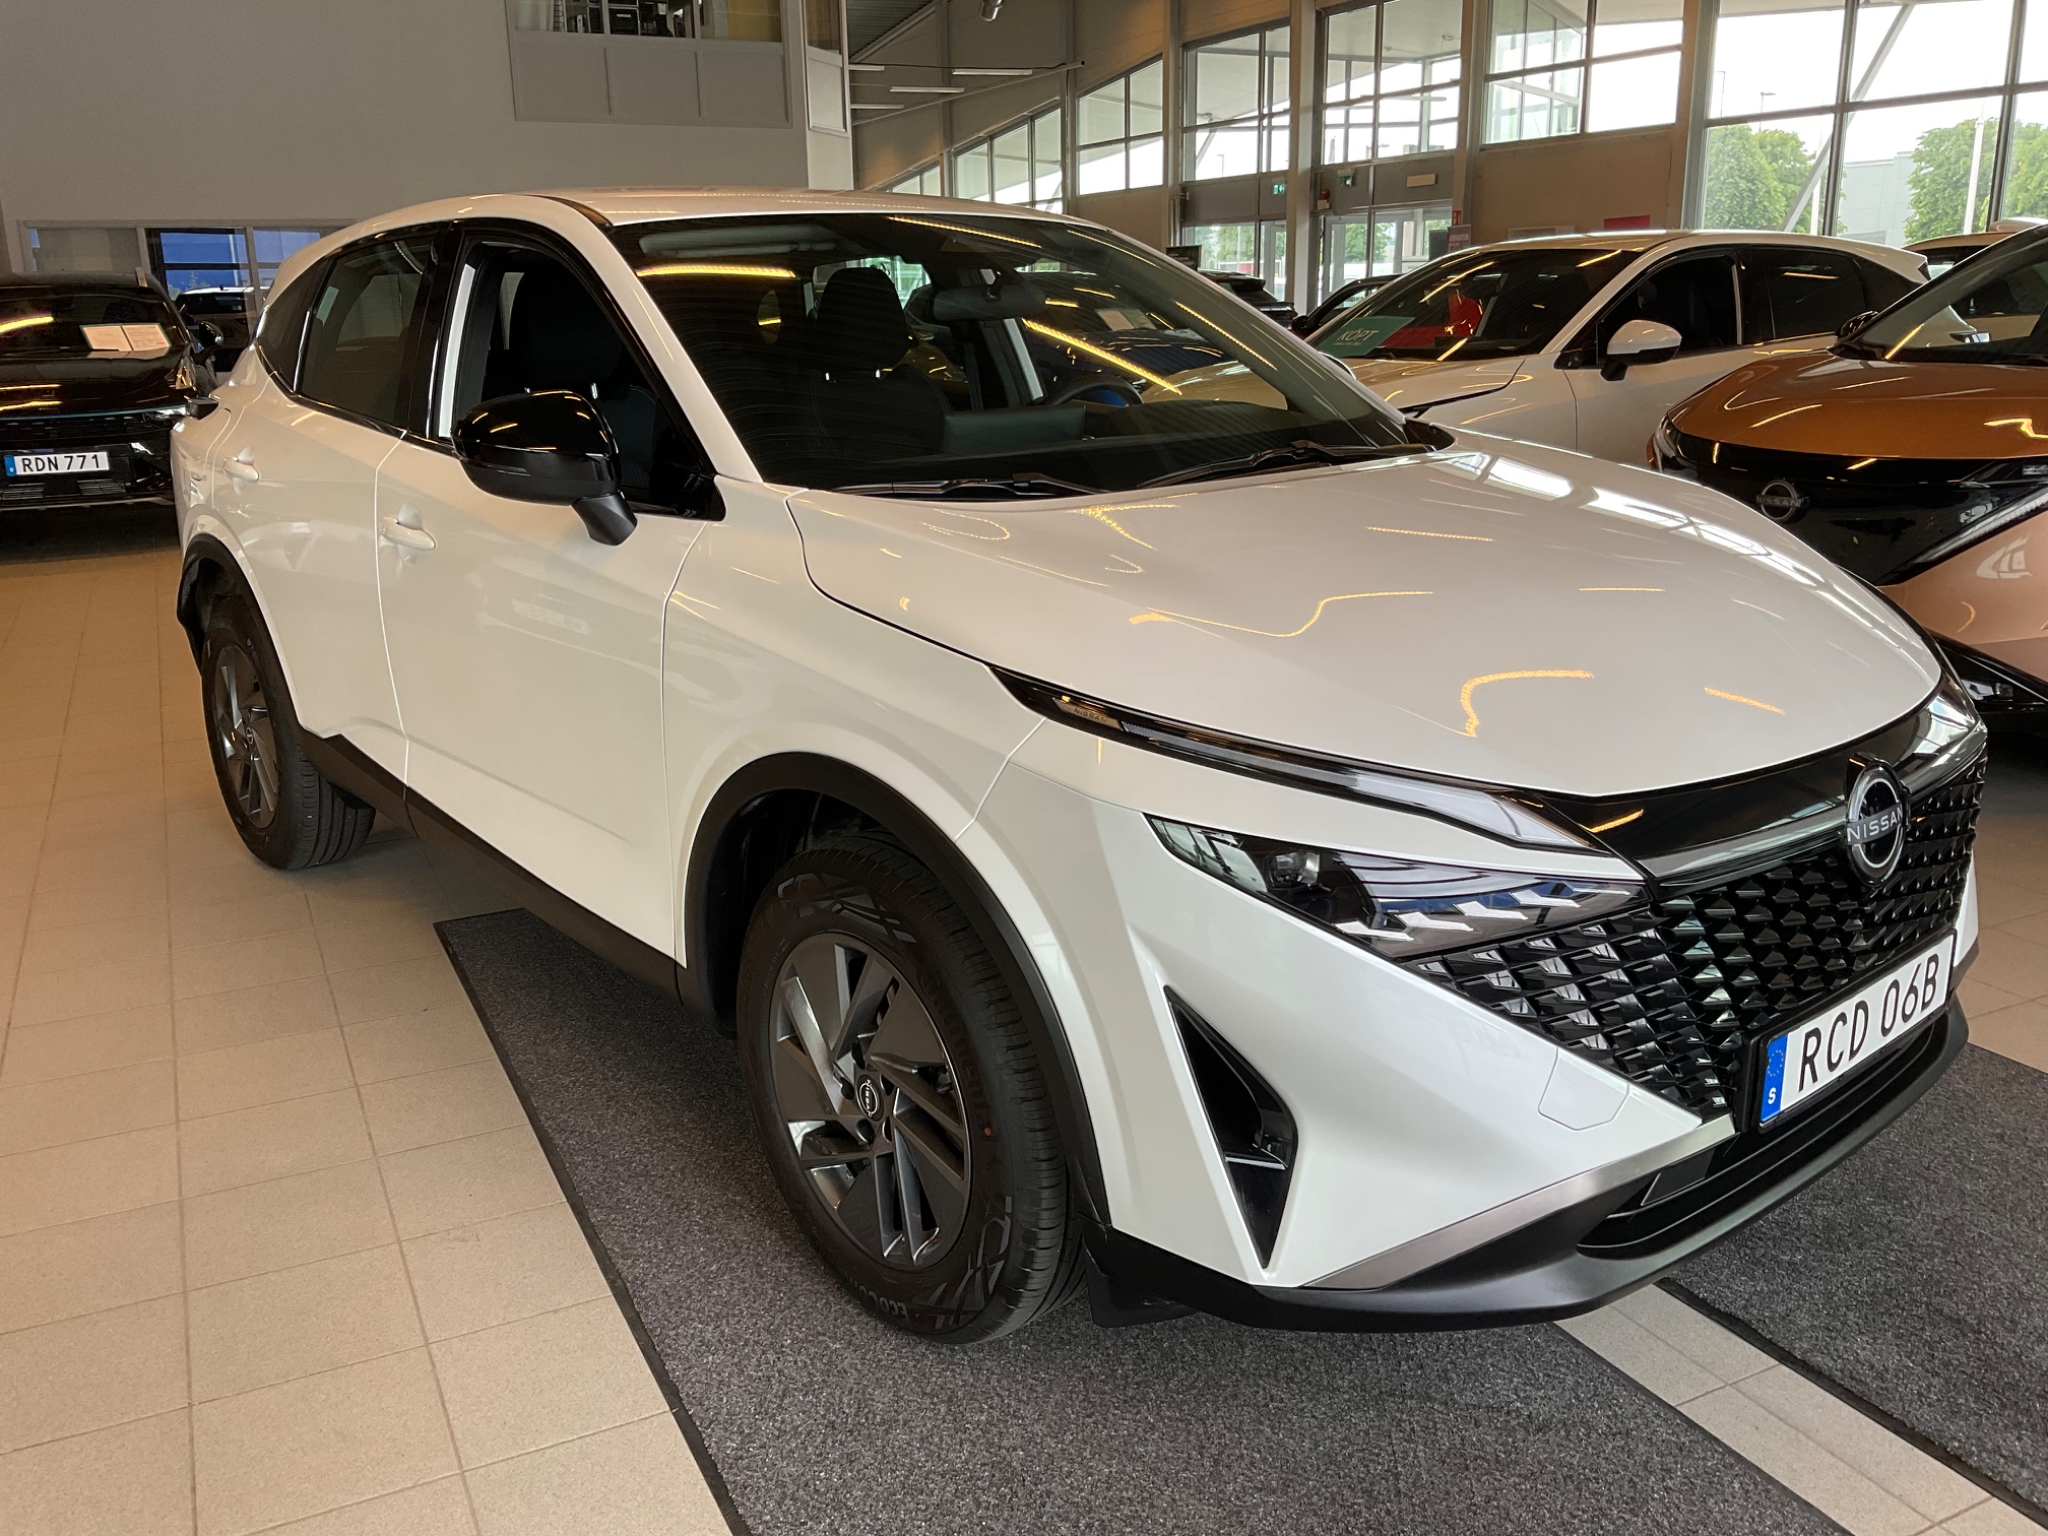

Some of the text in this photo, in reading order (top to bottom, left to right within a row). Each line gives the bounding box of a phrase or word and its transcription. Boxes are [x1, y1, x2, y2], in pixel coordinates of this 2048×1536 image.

[1336, 328, 1379, 341] KÖPT
[22, 454, 100, 472] RDN 771
[1756, 495, 1800, 507] NISSAN
[1846, 806, 1903, 842] NISSAN
[1798, 953, 1939, 1092] RCD 06B
[1767, 1087, 1776, 1104] S
